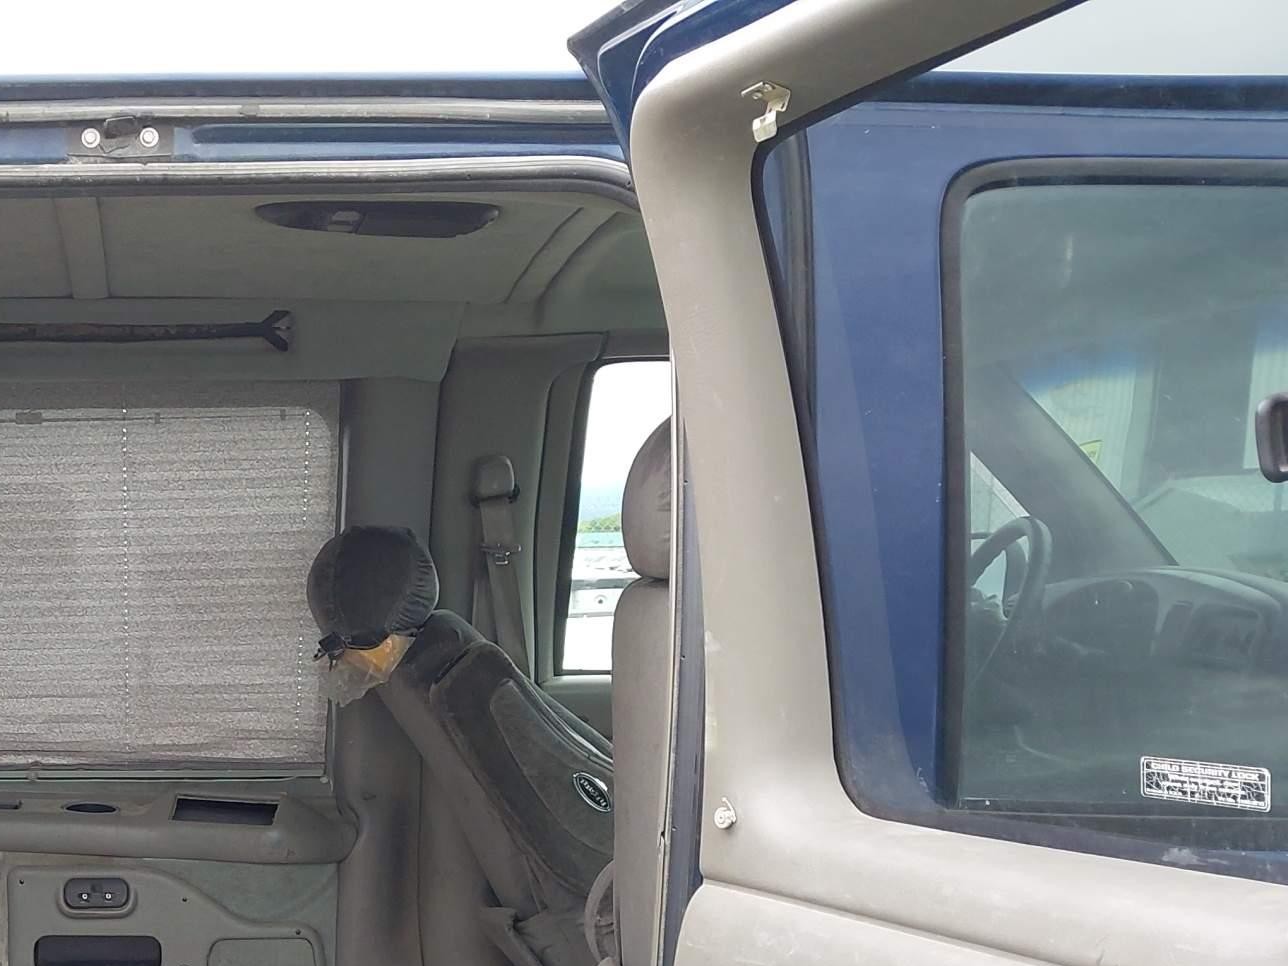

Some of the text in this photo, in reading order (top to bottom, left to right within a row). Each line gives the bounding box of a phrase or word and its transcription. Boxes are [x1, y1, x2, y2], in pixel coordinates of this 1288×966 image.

[1150, 761, 1180, 772] CHILD
[1181, 765, 1231, 779] SECURITY
[1230, 770, 1260, 781] LOCK
